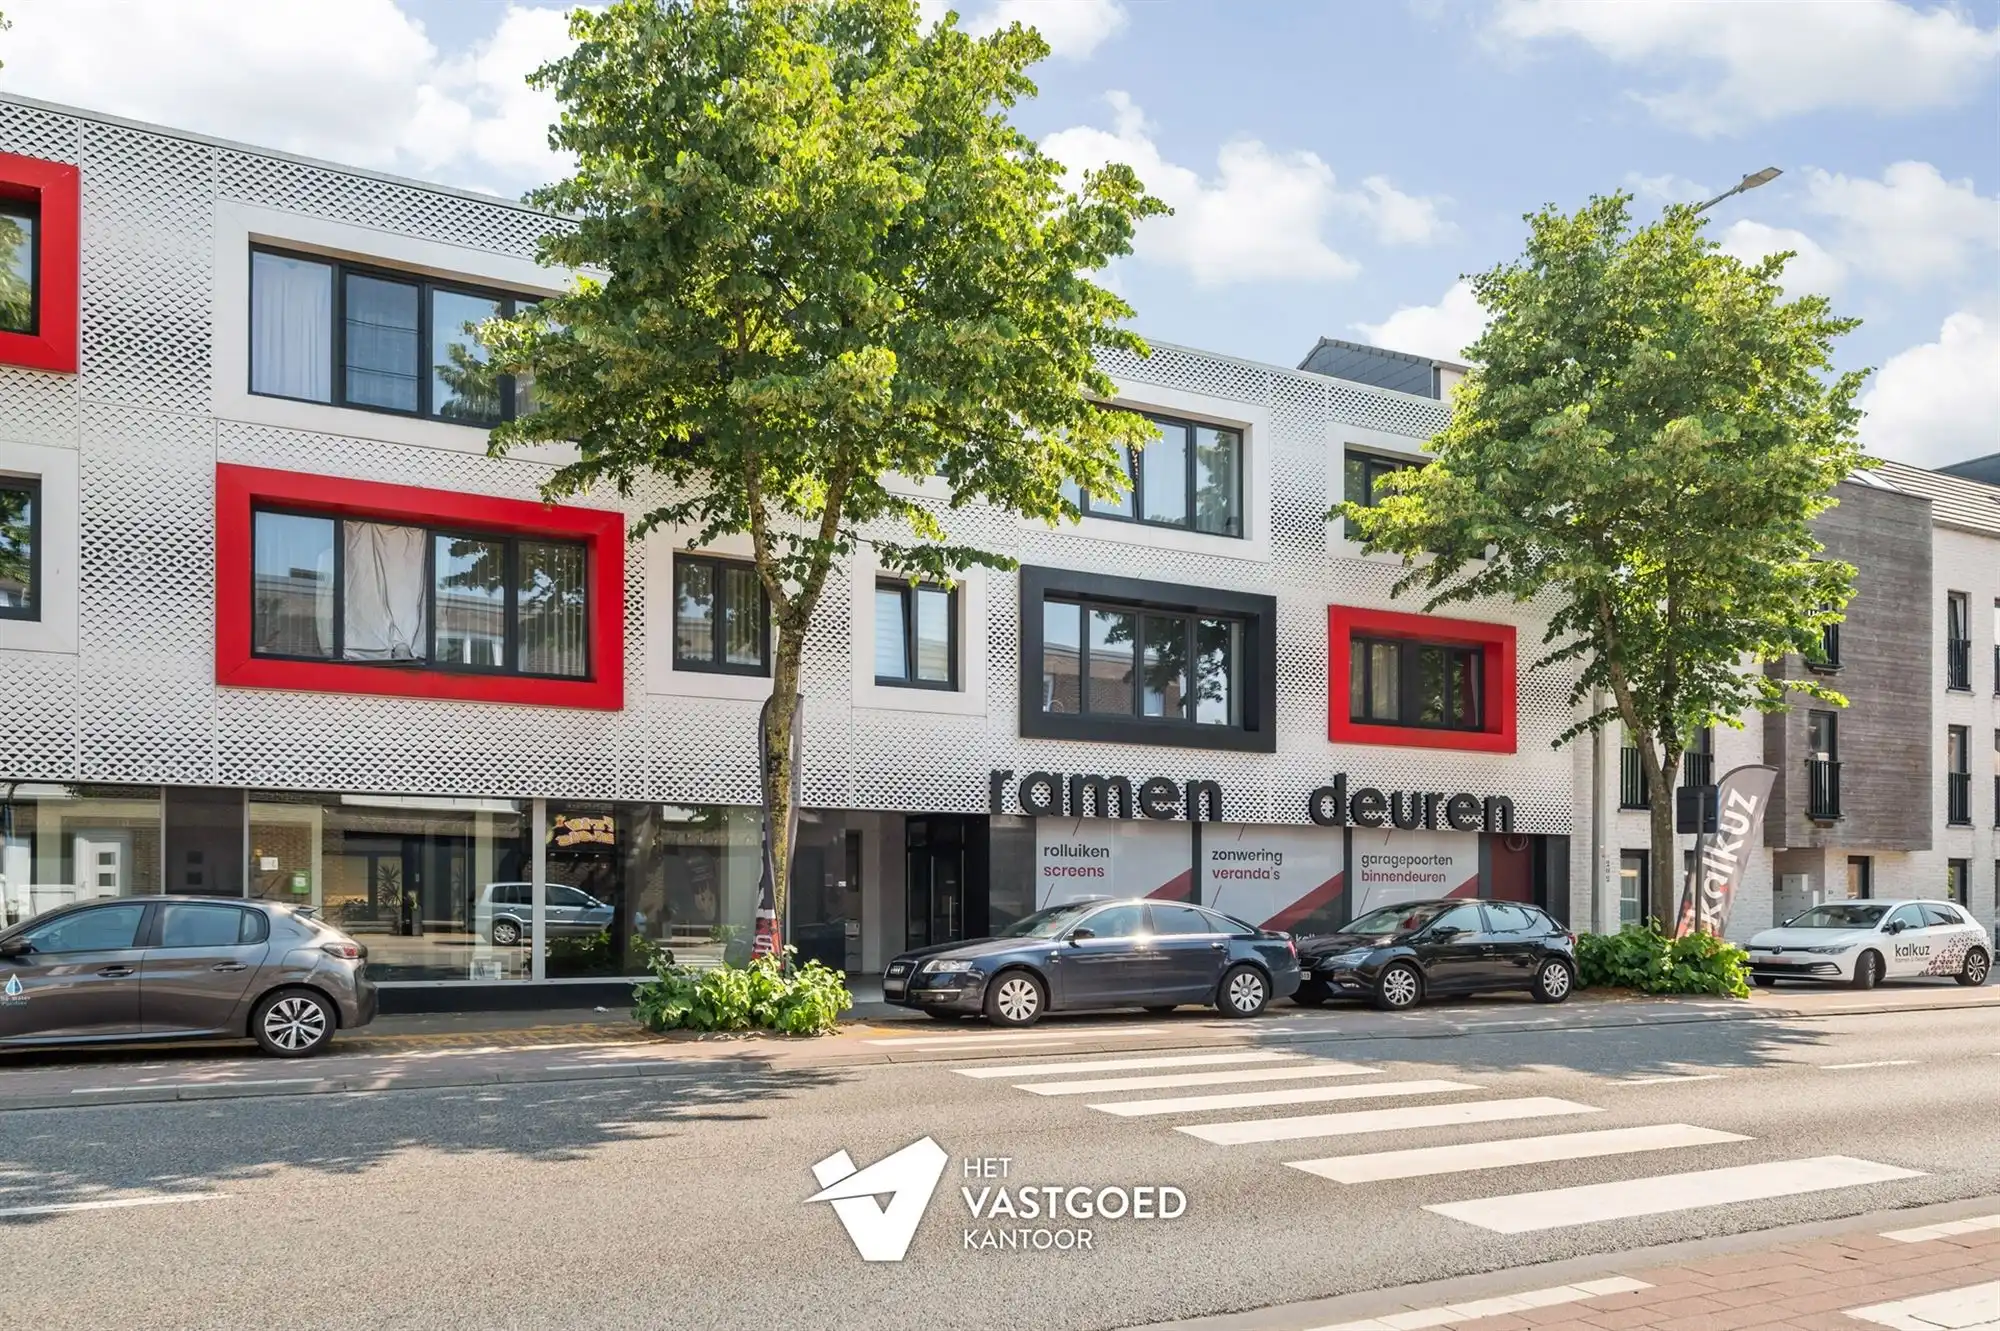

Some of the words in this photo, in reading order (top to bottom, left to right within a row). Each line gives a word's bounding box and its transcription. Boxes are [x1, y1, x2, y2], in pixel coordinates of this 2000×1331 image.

[990, 769, 1222, 822] ramen
[1309, 772, 1514, 833] deuren
[1043, 844, 1110, 858] rolluiken
[1211, 848, 1283, 865] zonwering
[1700, 788, 1758, 928] kalkuz
[1361, 853, 1453, 868] garagepoorten
[1043, 865, 1105, 878] screens
[1212, 866, 1281, 880] veranda's
[1361, 869, 1447, 883] binnendeuren
[1895, 943, 1931, 957] kalkuz
